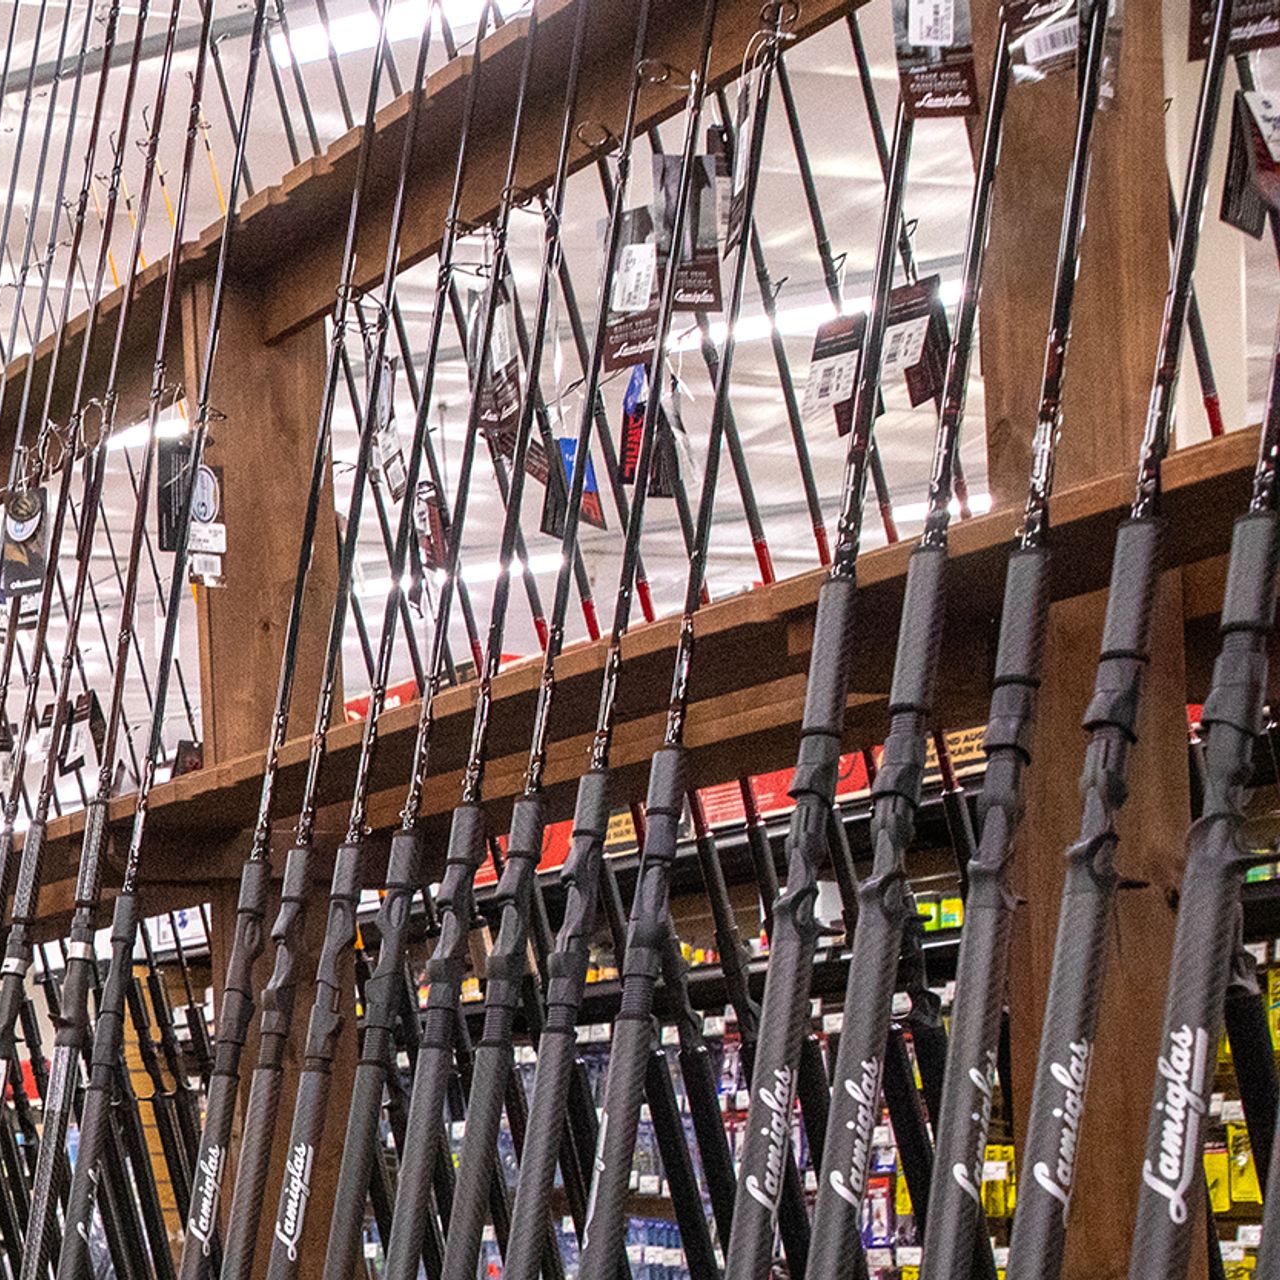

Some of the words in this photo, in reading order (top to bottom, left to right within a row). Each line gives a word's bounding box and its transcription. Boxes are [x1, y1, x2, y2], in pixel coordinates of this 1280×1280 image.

[188, 1143, 227, 1255] Lamiglas
[274, 1140, 315, 1262] Lamiglas
[746, 1064, 797, 1232] Lamiglas
[831, 1056, 883, 1228] Lamiglas
[1034, 1036, 1095, 1228] Lamiglas
[1143, 1024, 1209, 1226] Lamiglas
